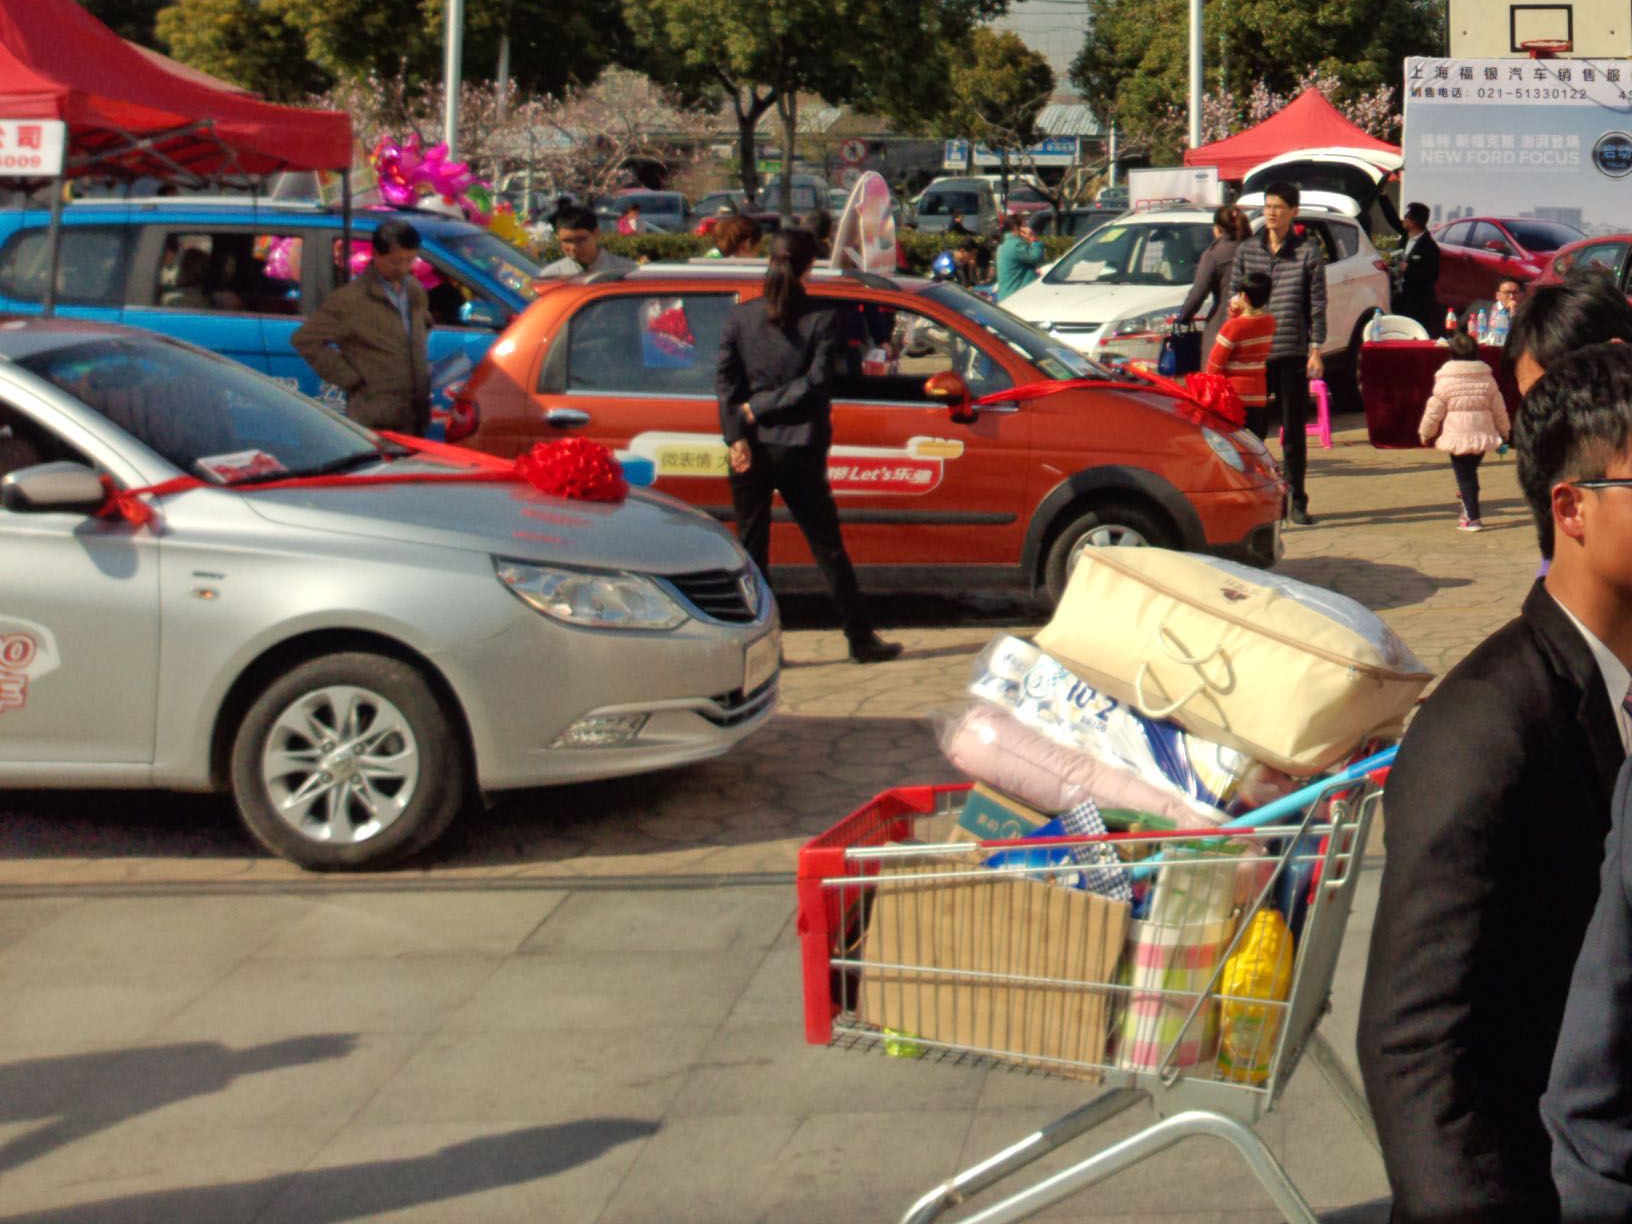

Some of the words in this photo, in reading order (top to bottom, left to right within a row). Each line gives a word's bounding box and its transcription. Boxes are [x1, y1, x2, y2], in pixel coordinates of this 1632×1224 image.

[1420, 150, 1463, 165] NEW
[1466, 150, 1517, 165] FORD
[1519, 150, 1581, 165] FOCUS
[849, 466, 892, 481] Let's
